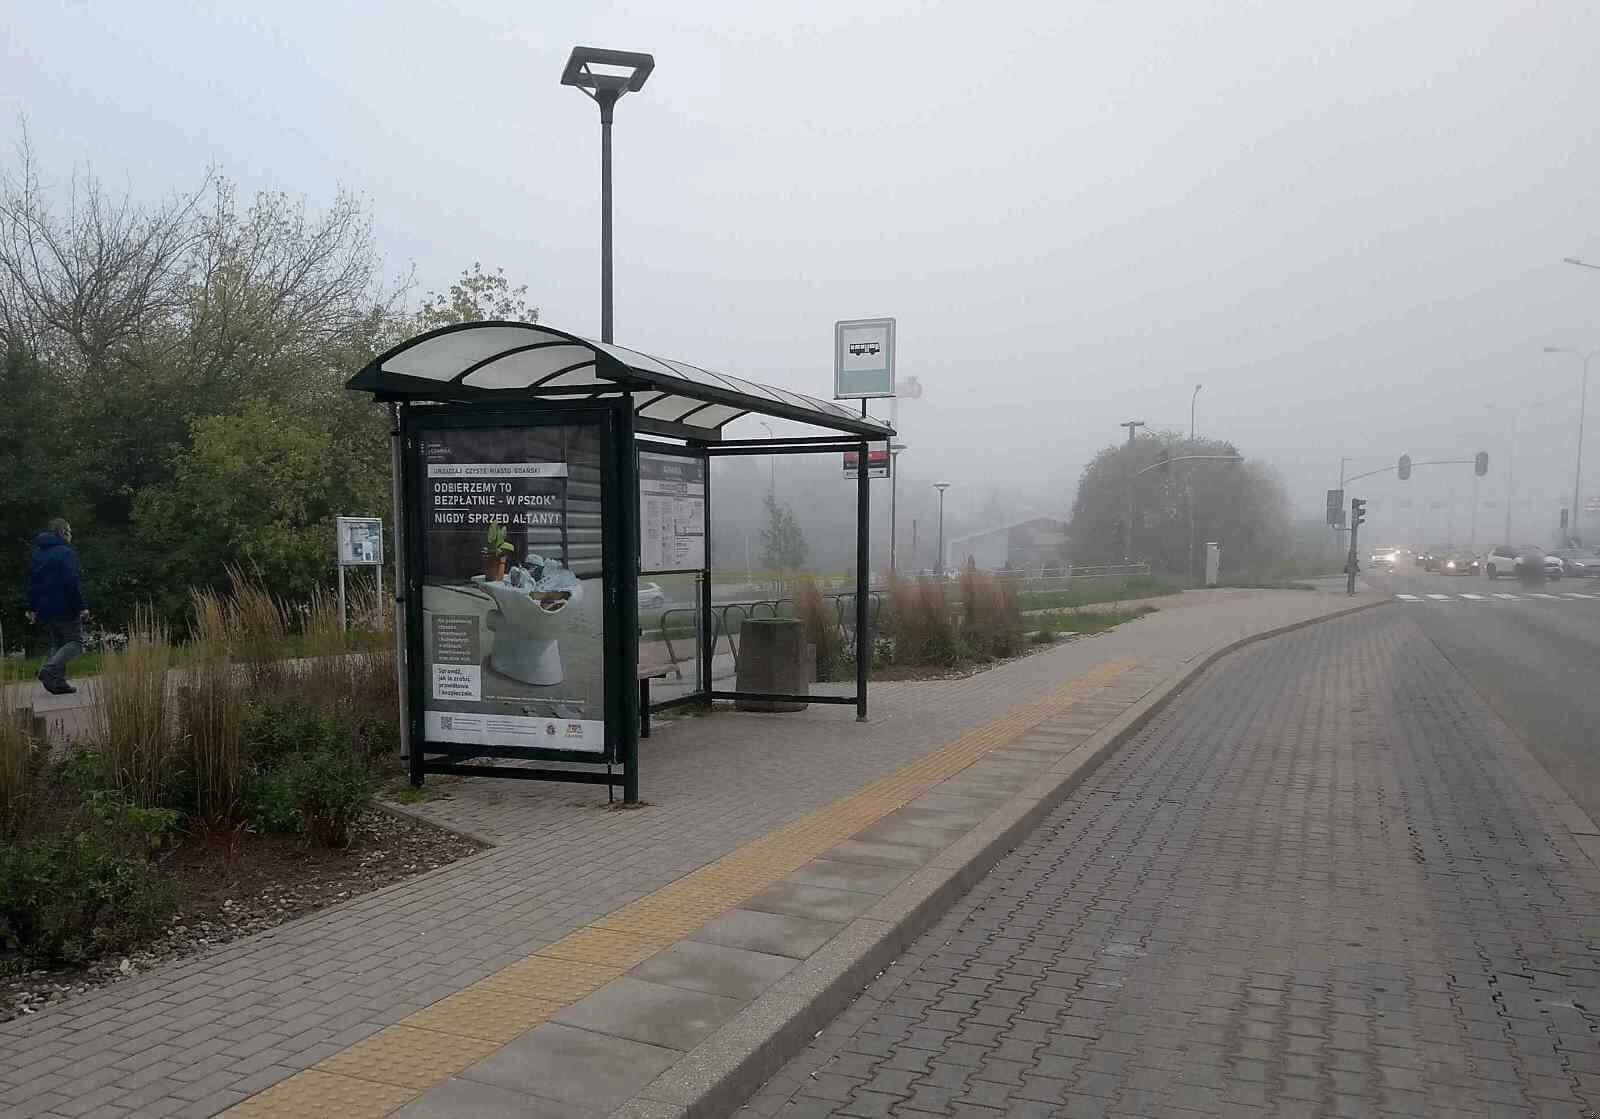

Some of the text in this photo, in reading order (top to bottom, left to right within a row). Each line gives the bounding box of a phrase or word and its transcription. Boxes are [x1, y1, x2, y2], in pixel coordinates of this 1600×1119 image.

[434, 482, 512, 493] ODBIERZEMY TO
[434, 495, 495, 505] BEZPŁATNIE
[506, 495, 516, 505] W
[434, 512, 560, 524] NIGDY SPRZED ALTANY!
